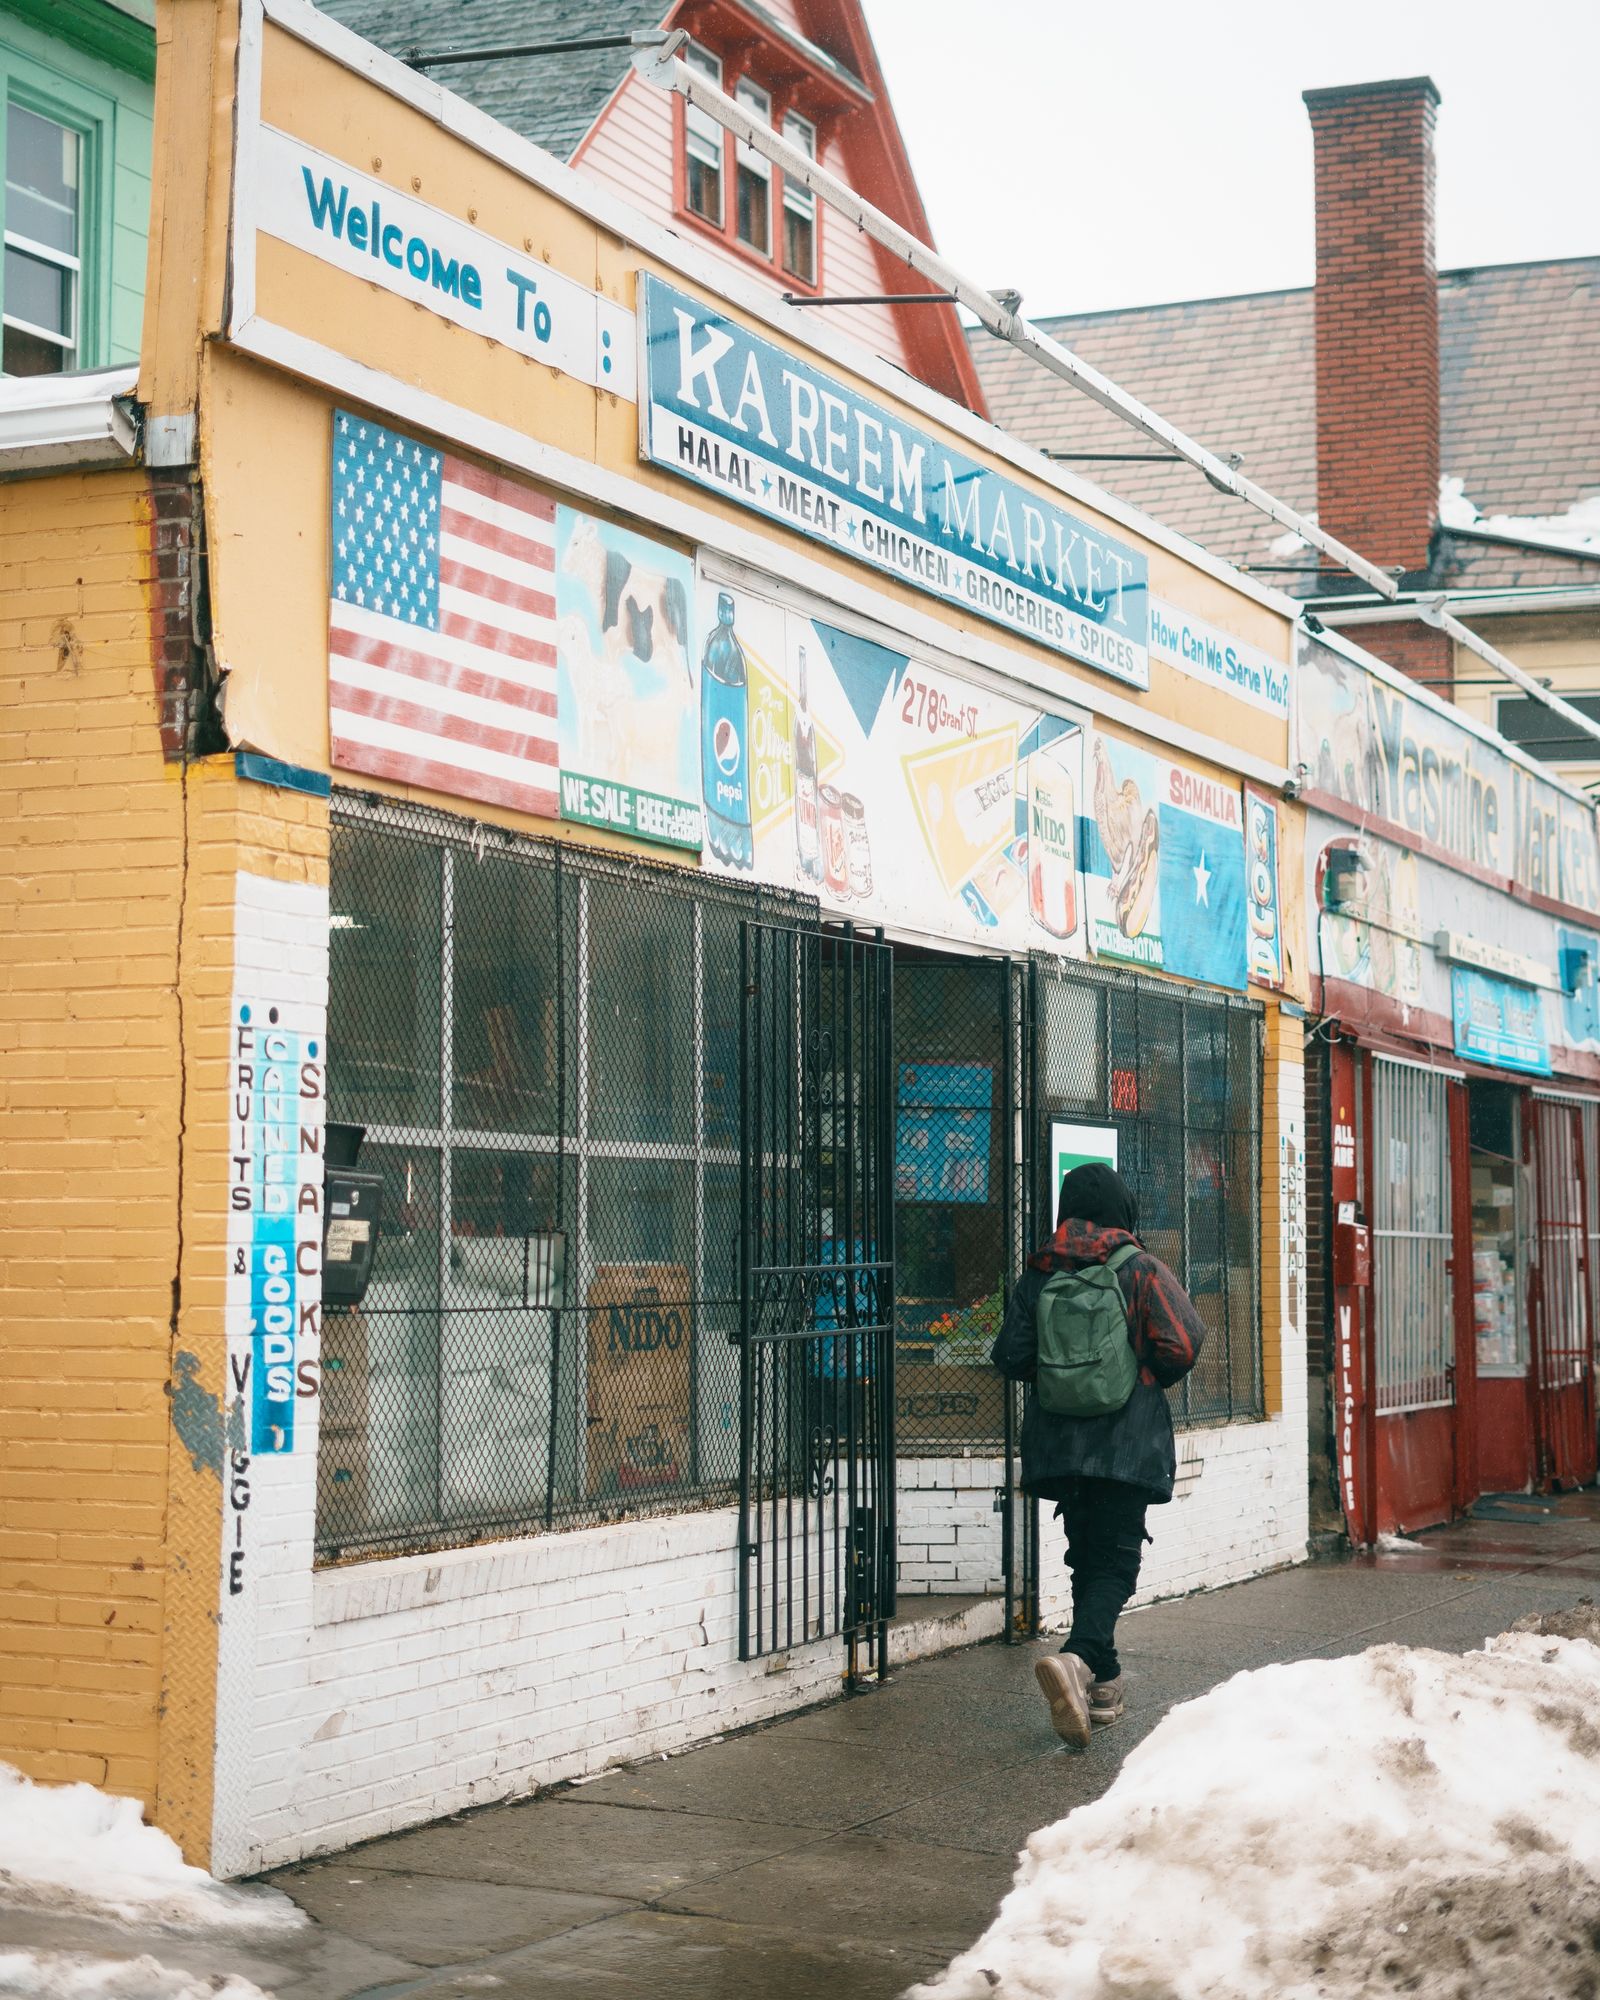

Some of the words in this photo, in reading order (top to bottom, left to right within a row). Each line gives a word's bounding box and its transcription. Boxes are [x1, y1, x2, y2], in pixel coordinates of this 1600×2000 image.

[506, 267, 553, 344] To
[673, 306, 927, 524] KAREEM
[941, 459, 1133, 627] MARKET
[677, 425, 757, 496] HALAL
[778, 475, 841, 535] MEAT
[861, 518, 949, 588] CHICKEN
[966, 569, 1064, 641] GROCERIES
[1079, 623, 1134, 673] SPICES
[1151, 609, 1179, 652] How
[1181, 626, 1205, 666] Can
[1205, 636, 1223, 675] We
[1225, 647, 1261, 694] Serve
[1263, 665, 1289, 707] You?
[752, 707, 793, 766] Olive
[901, 678, 938, 734] 278
[937, 693, 966, 733] Grant
[562, 776, 591, 816] WE
[716, 780, 743, 806] pepsi
[1169, 768, 1238, 826] SOMALIA
[1368, 676, 1500, 873] Yasmine
[1032, 804, 1067, 848] NIDO
[1250, 802, 1279, 983] COLD
[231, 1026, 255, 1211] FRUITS
[1333, 1123, 1355, 1146] ALL
[1333, 1146, 1355, 1169] ARE
[232, 1246, 247, 1276] &
[296, 1062, 322, 1398] SNACKS
[263, 1243, 294, 1403] GOODS
[608, 1302, 684, 1352] NIDO
[1339, 1304, 1355, 1512] WELCOME
[229, 1352, 251, 1597] VGGIE
